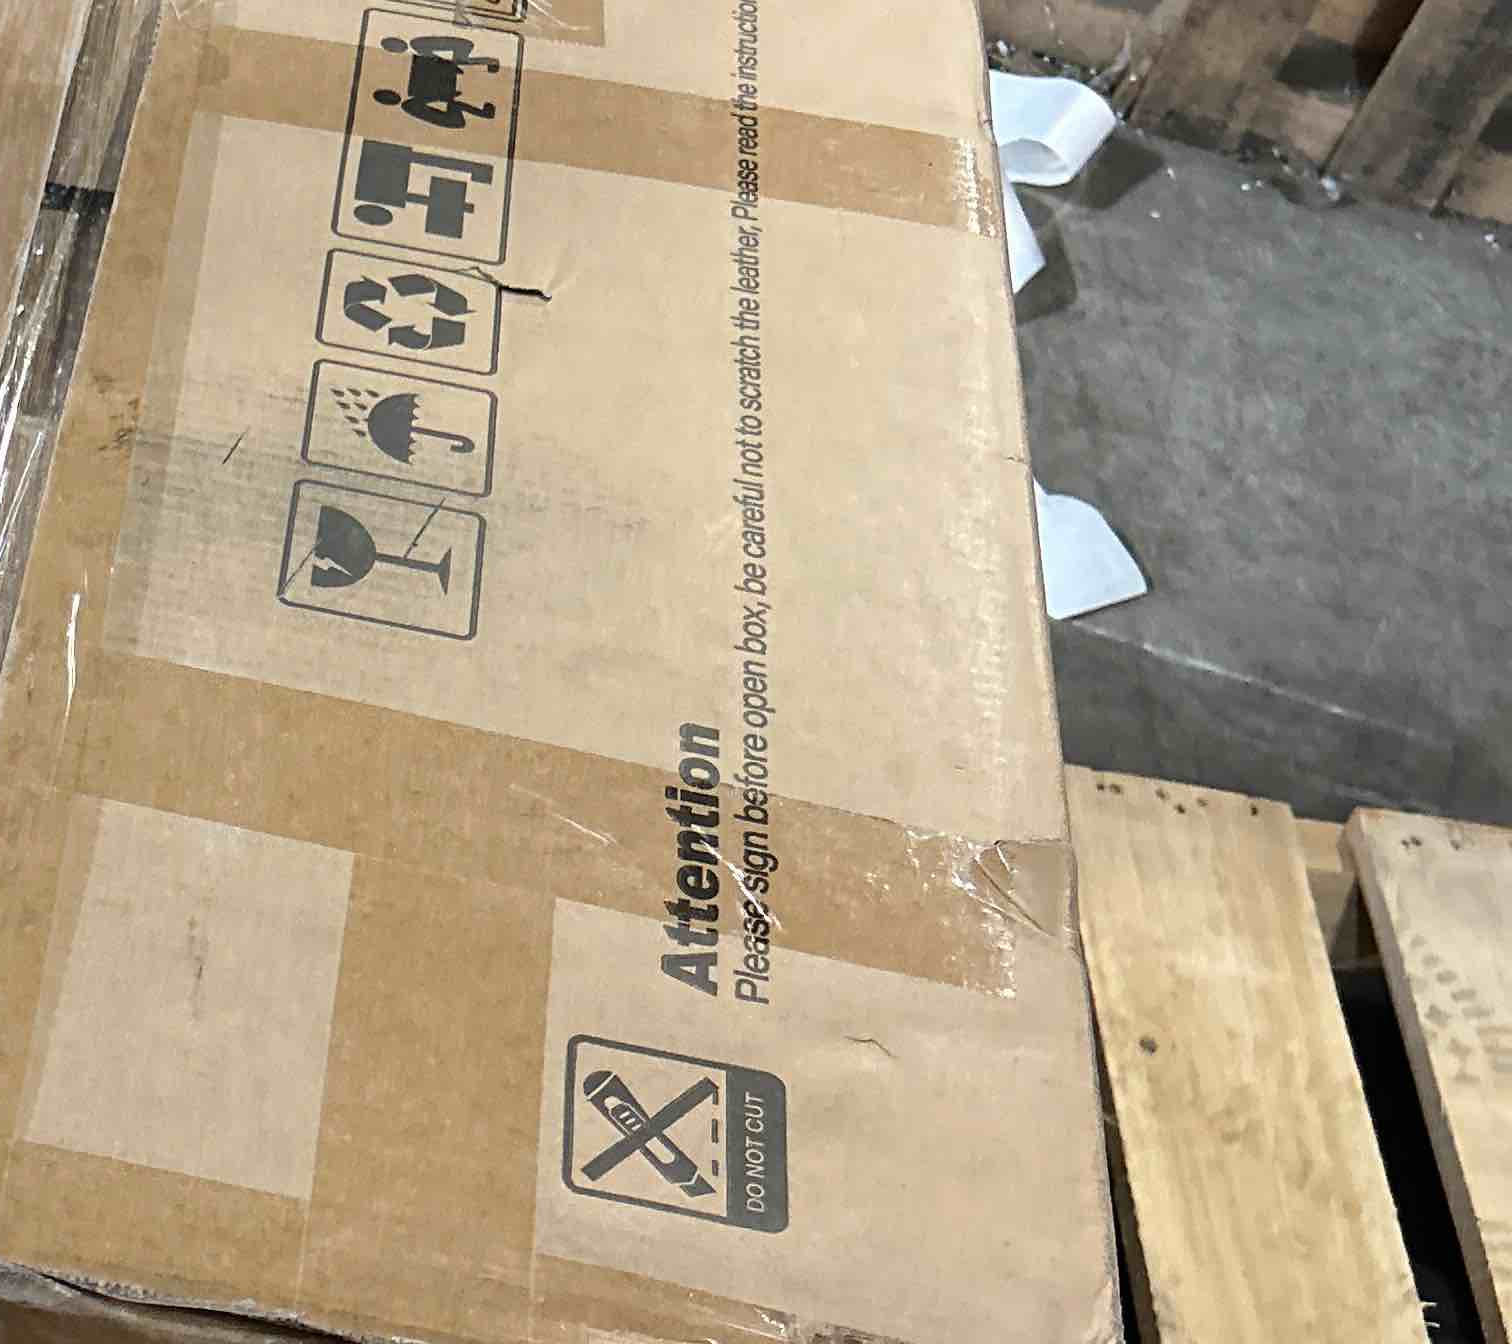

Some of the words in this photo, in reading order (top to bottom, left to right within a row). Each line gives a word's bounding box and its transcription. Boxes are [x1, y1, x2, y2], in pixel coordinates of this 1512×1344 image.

[730, 82, 758, 112] the
[730, 111, 758, 157] read
[730, 157, 758, 222] Please
[729, 224, 763, 295] leather,
[729, 296, 760, 331] the
[731, 333, 762, 412] scratch
[733, 413, 762, 437] to
[734, 438, 763, 478] not
[732, 476, 765, 559] careful
[733, 561, 765, 597] be
[733, 600, 772, 656] box,
[742, 658, 776, 729] open
[732, 732, 769, 826] before
[661, 722, 721, 997] Attention
[741, 829, 779, 895] sign
[733, 898, 771, 1005] Please
[744, 1091, 765, 1133] CUT
[744, 1139, 765, 1178] NOT
[745, 1183, 765, 1214] DO
